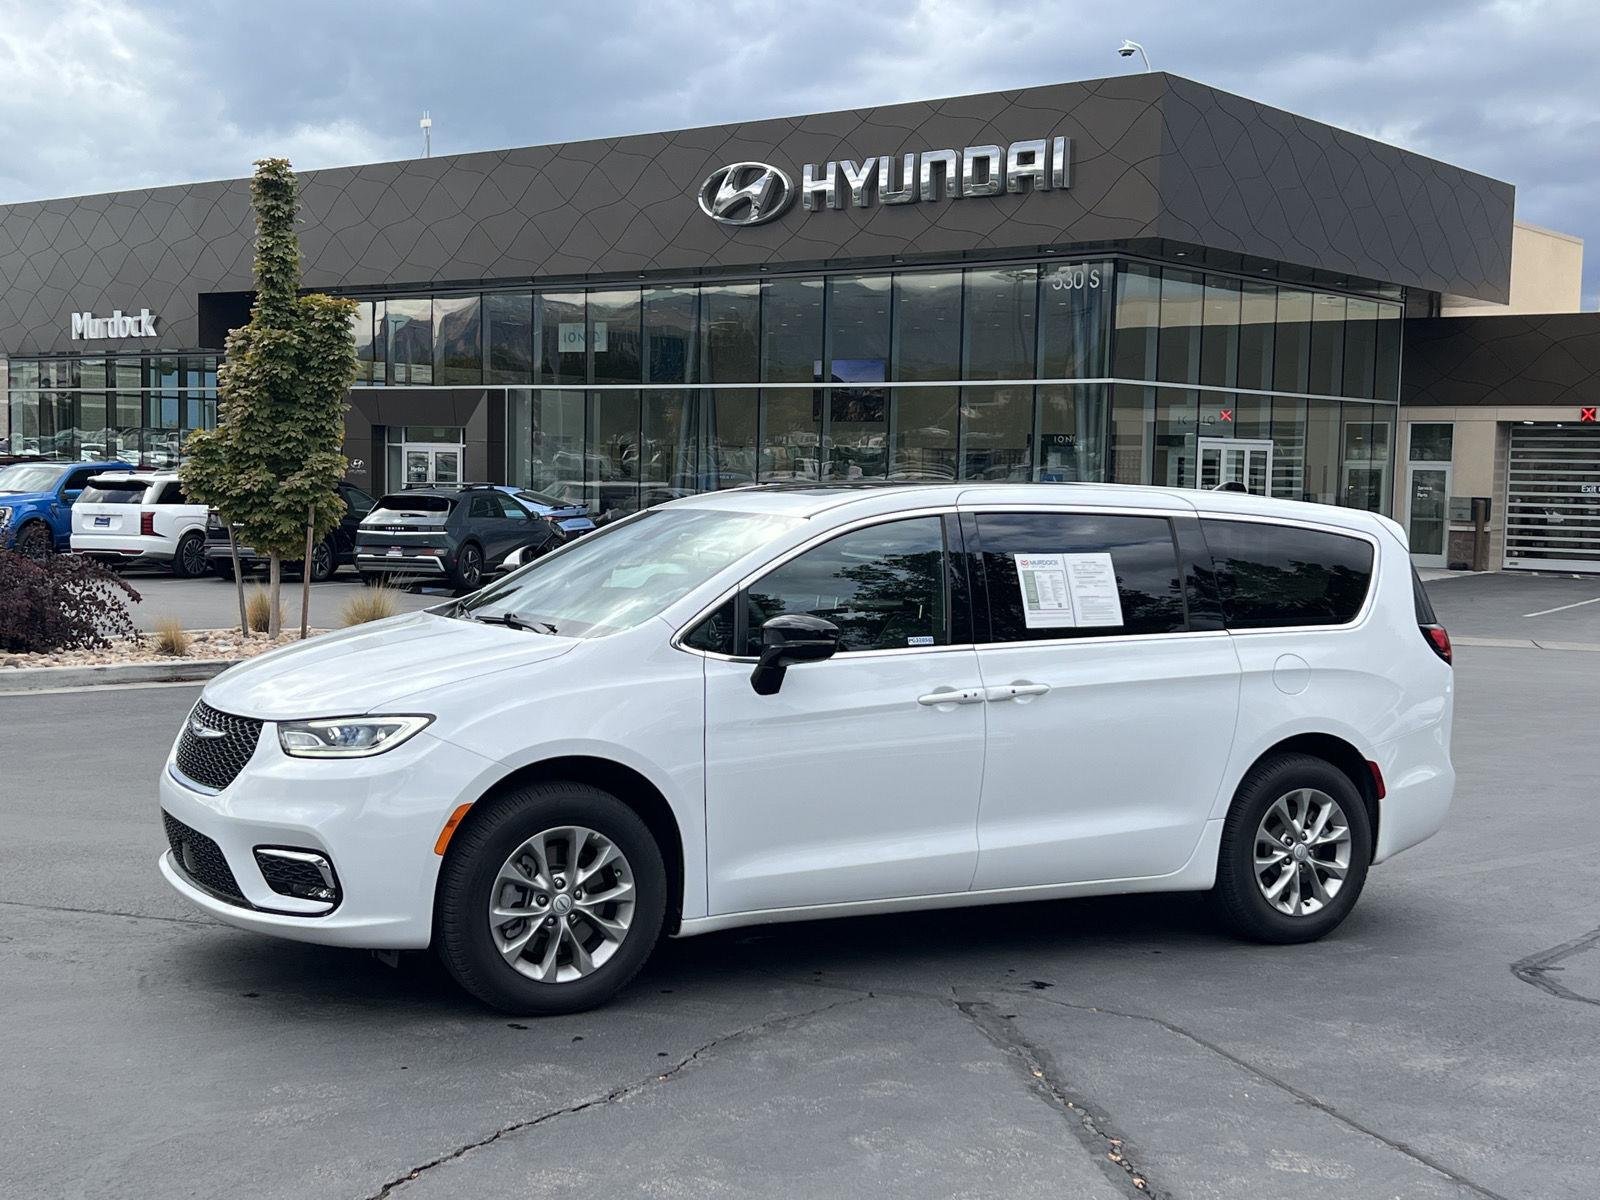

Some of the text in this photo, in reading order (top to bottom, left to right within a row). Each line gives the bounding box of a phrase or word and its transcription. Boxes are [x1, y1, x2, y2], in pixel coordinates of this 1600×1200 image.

[803, 136, 1071, 212] HYUNDAI
[1090, 269, 1100, 289] S
[71, 308, 158, 340] Murdock
[1581, 485, 1596, 493] Exit
